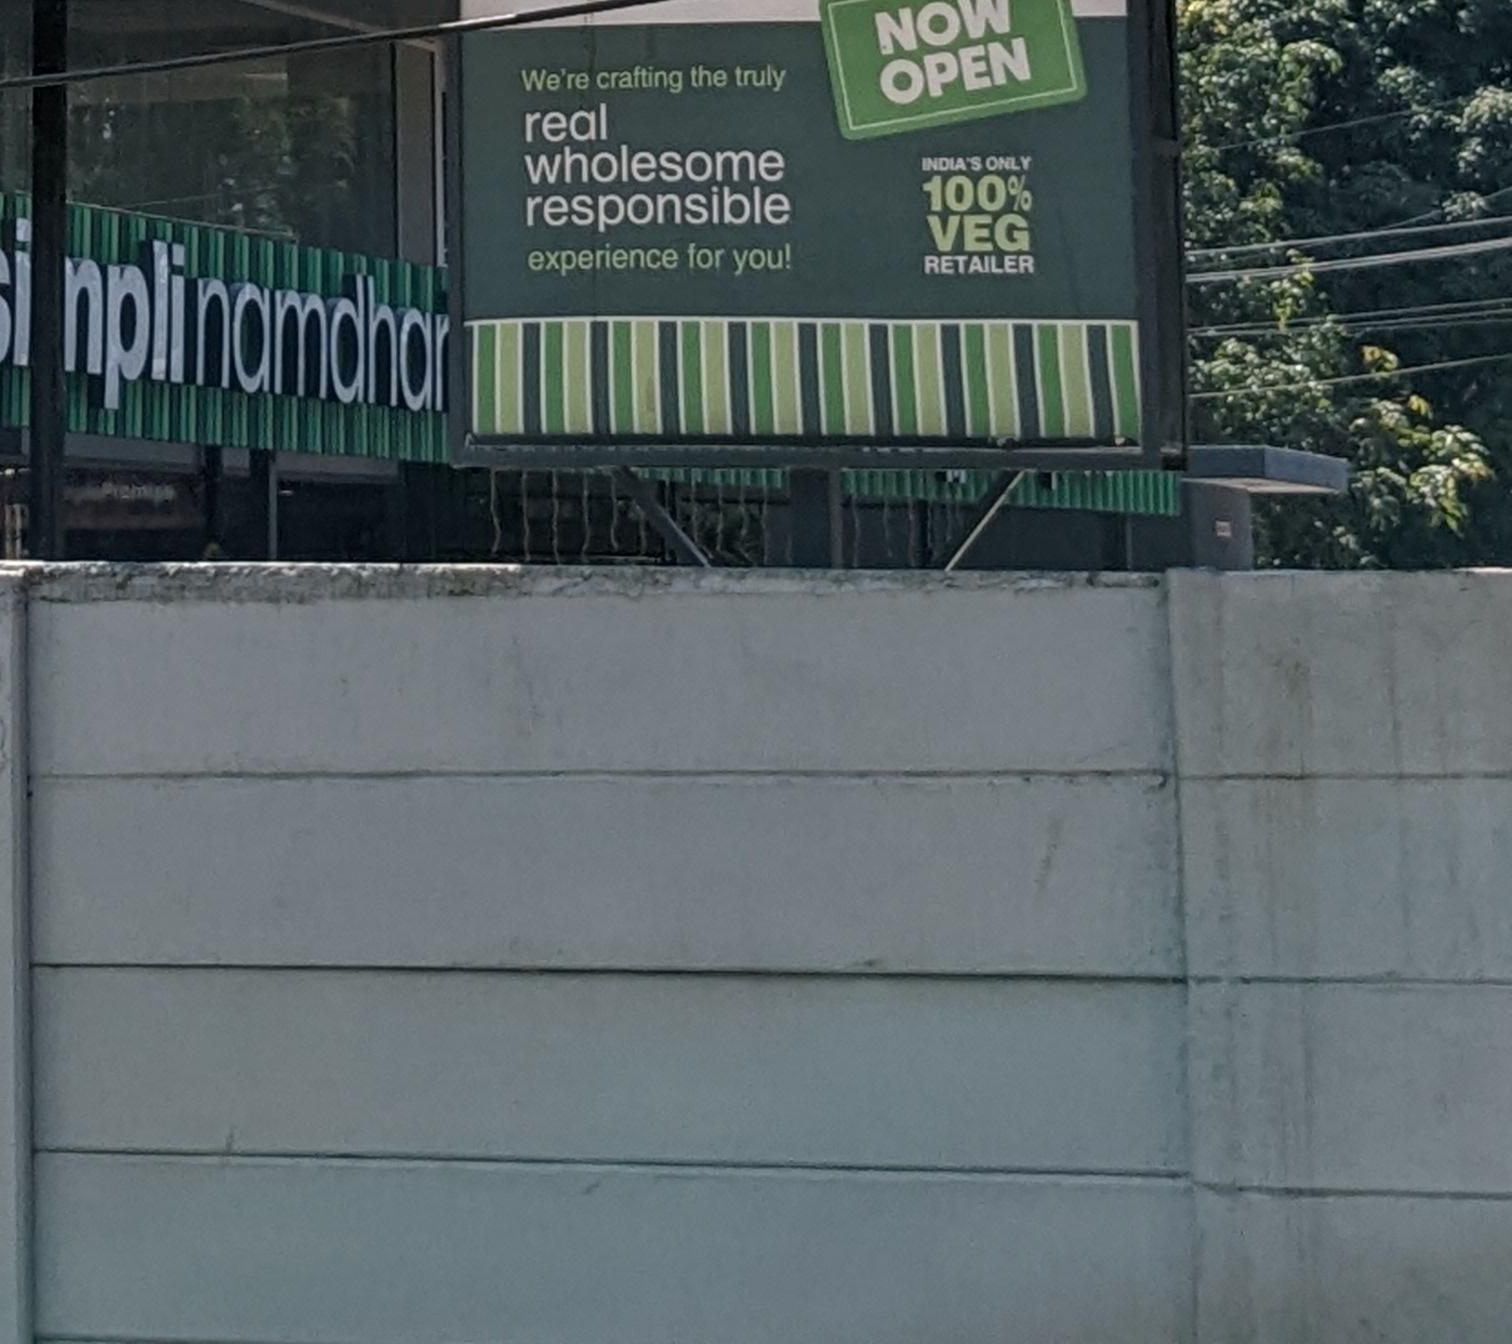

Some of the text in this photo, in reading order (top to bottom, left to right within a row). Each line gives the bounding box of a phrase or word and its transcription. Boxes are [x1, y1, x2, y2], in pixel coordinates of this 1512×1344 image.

[596, 65, 684, 94] crafting
[690, 65, 728, 88] the
[734, 64, 787, 92] truly
[879, 37, 1032, 104] OPEN
[524, 102, 608, 143] real
[524, 144, 786, 184] wholesome
[985, 155, 1033, 171] ONLY
[526, 186, 791, 233] responsible
[922, 174, 1033, 212] 100%
[926, 213, 1031, 253] VEG
[527, 242, 792, 277] experience for you!
[924, 255, 1035, 275] RETAILER
